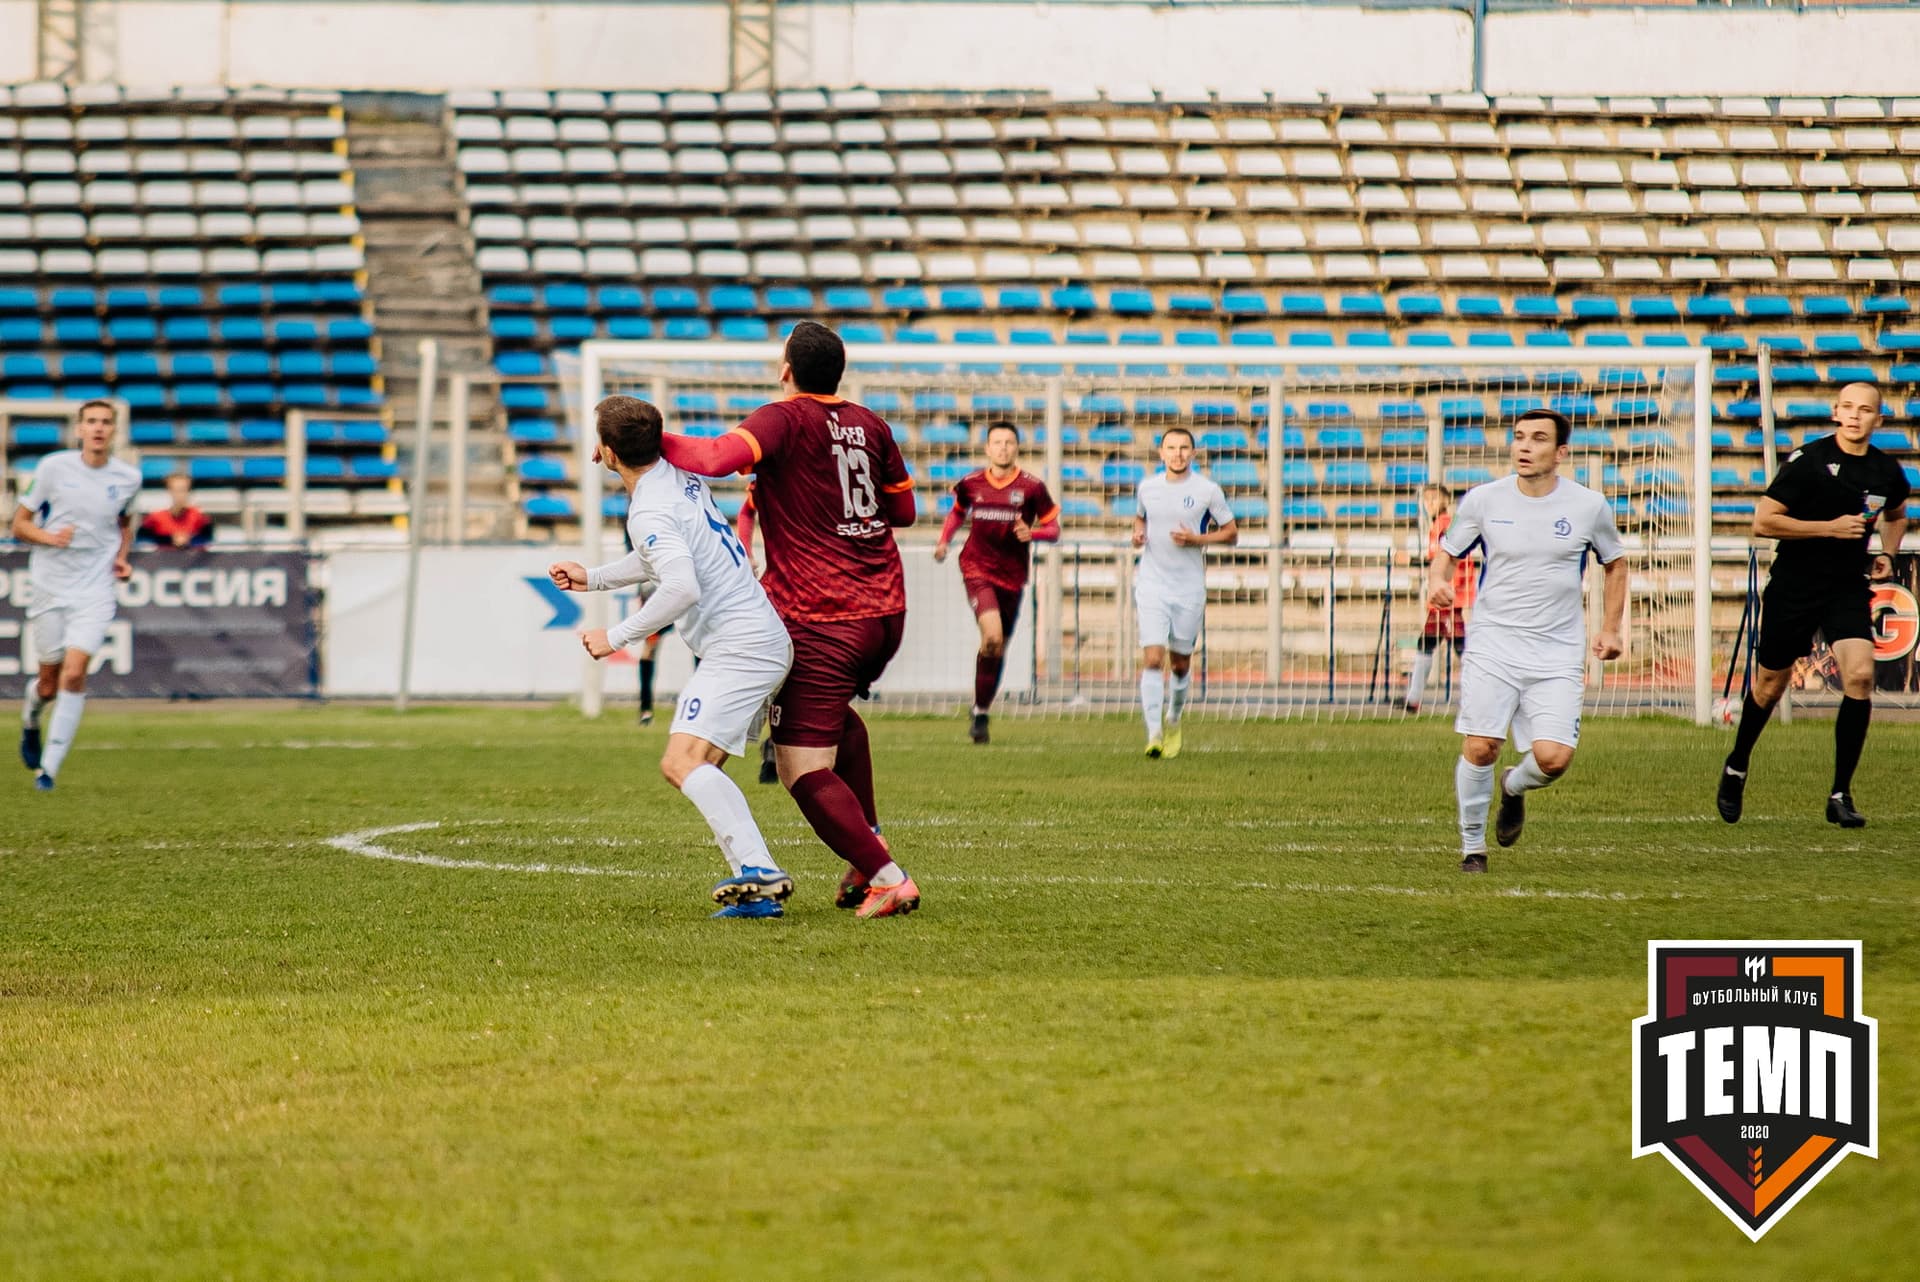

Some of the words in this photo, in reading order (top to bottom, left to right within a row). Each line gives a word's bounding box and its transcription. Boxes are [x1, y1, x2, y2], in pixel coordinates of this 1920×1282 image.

[832, 444, 879, 519] 13
[114, 566, 288, 608] ОССИЯ
[679, 698, 702, 721] 19
[770, 704, 782, 727] 13
